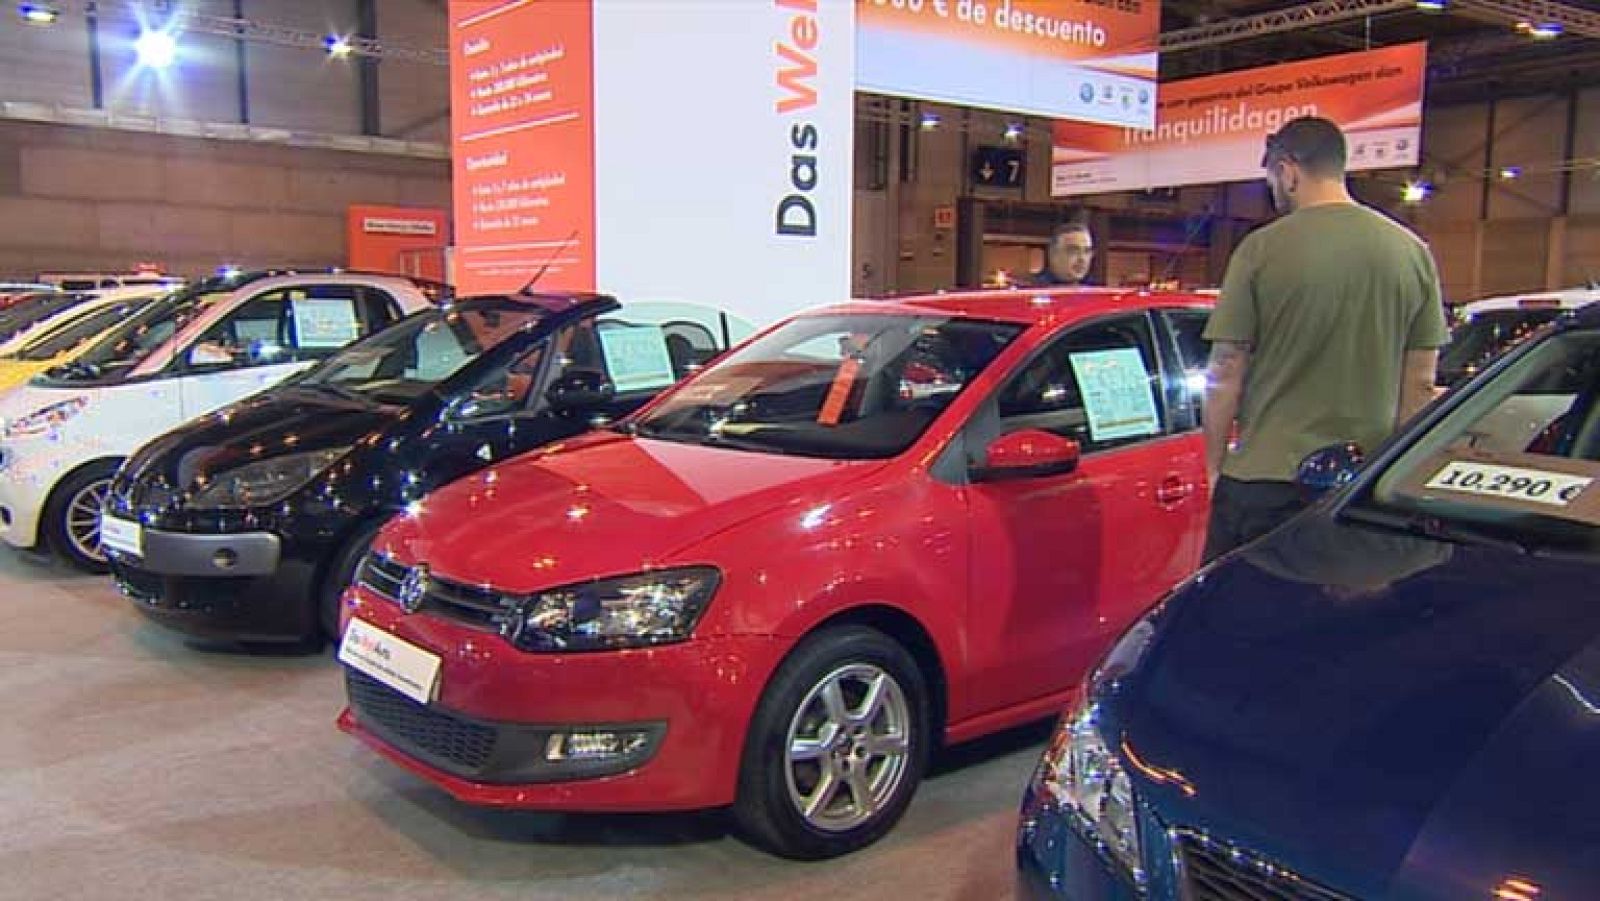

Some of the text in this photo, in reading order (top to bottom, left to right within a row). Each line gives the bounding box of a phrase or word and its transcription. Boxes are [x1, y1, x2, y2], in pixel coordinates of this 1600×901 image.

[955, 0, 986, 26] de
[994, 0, 1105, 46] descuento
[777, 123, 818, 236] Das
[1006, 160, 1019, 182] 7
